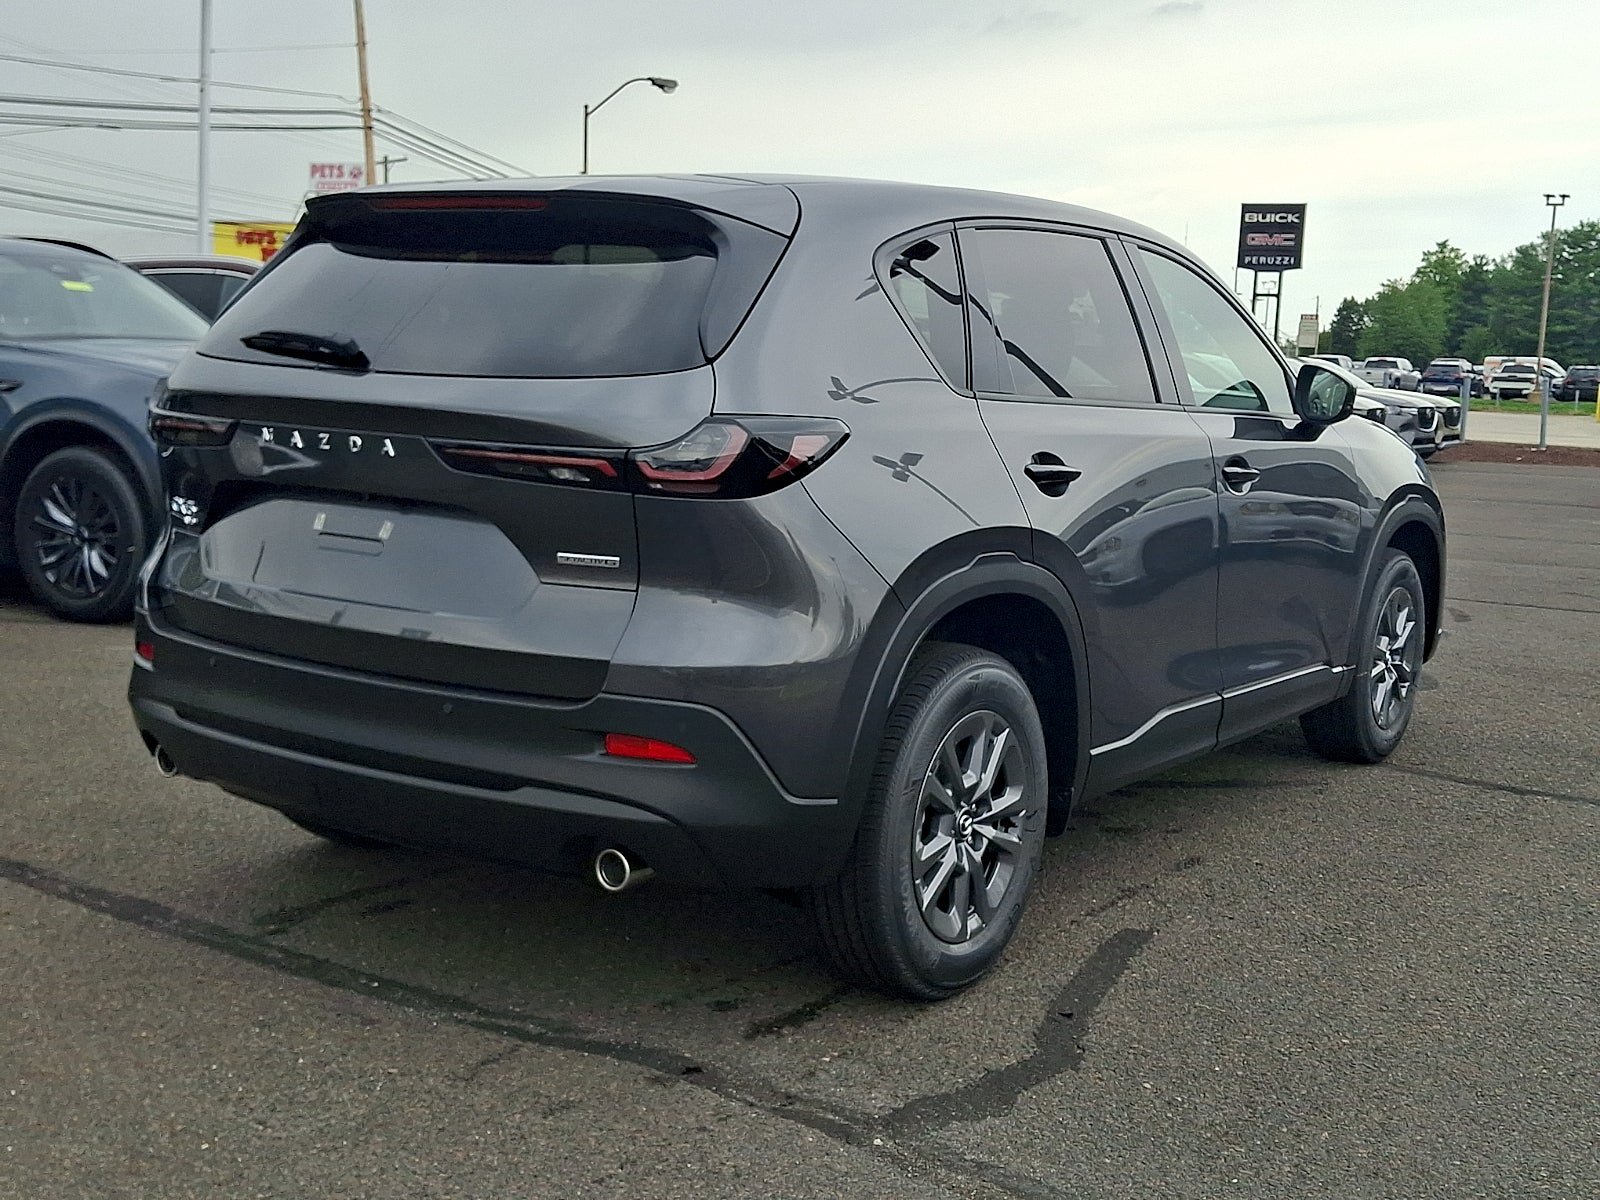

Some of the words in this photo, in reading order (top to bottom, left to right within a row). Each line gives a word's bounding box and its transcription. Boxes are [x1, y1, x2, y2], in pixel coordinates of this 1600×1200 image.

[310, 164, 344, 178] PETS
[1244, 212, 1300, 223] BUICK
[1246, 233, 1296, 246] GMC
[1244, 256, 1295, 265] PERUZZI
[261, 426, 395, 457] MAZDA
